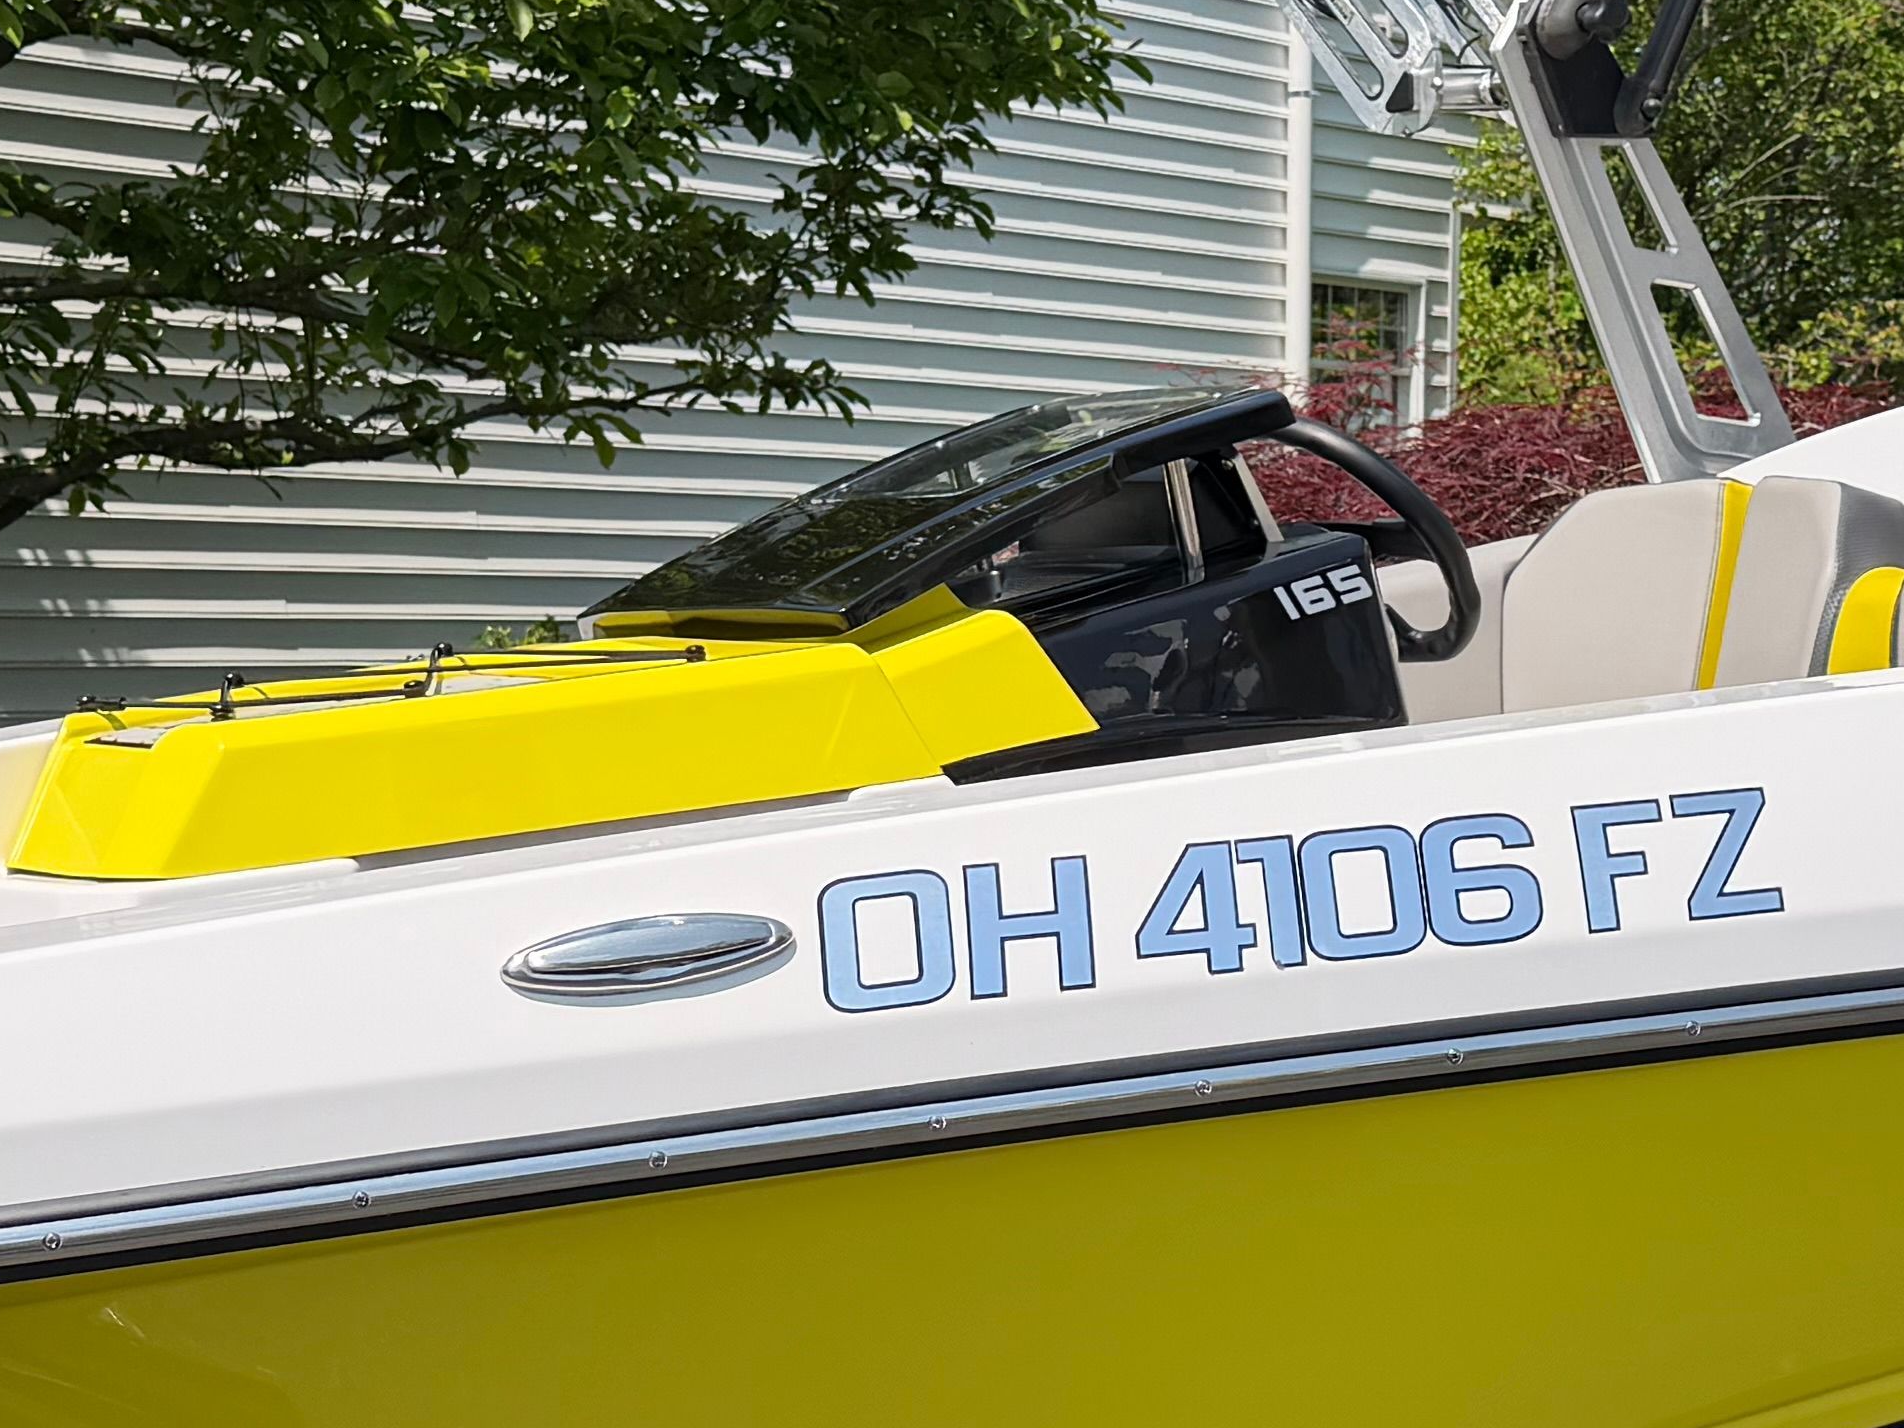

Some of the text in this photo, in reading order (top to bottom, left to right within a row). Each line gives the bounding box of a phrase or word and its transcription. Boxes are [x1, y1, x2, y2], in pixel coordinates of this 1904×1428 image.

[1274, 565, 1373, 620] 165
[819, 787, 1785, 1013] OH 4106 FZ
